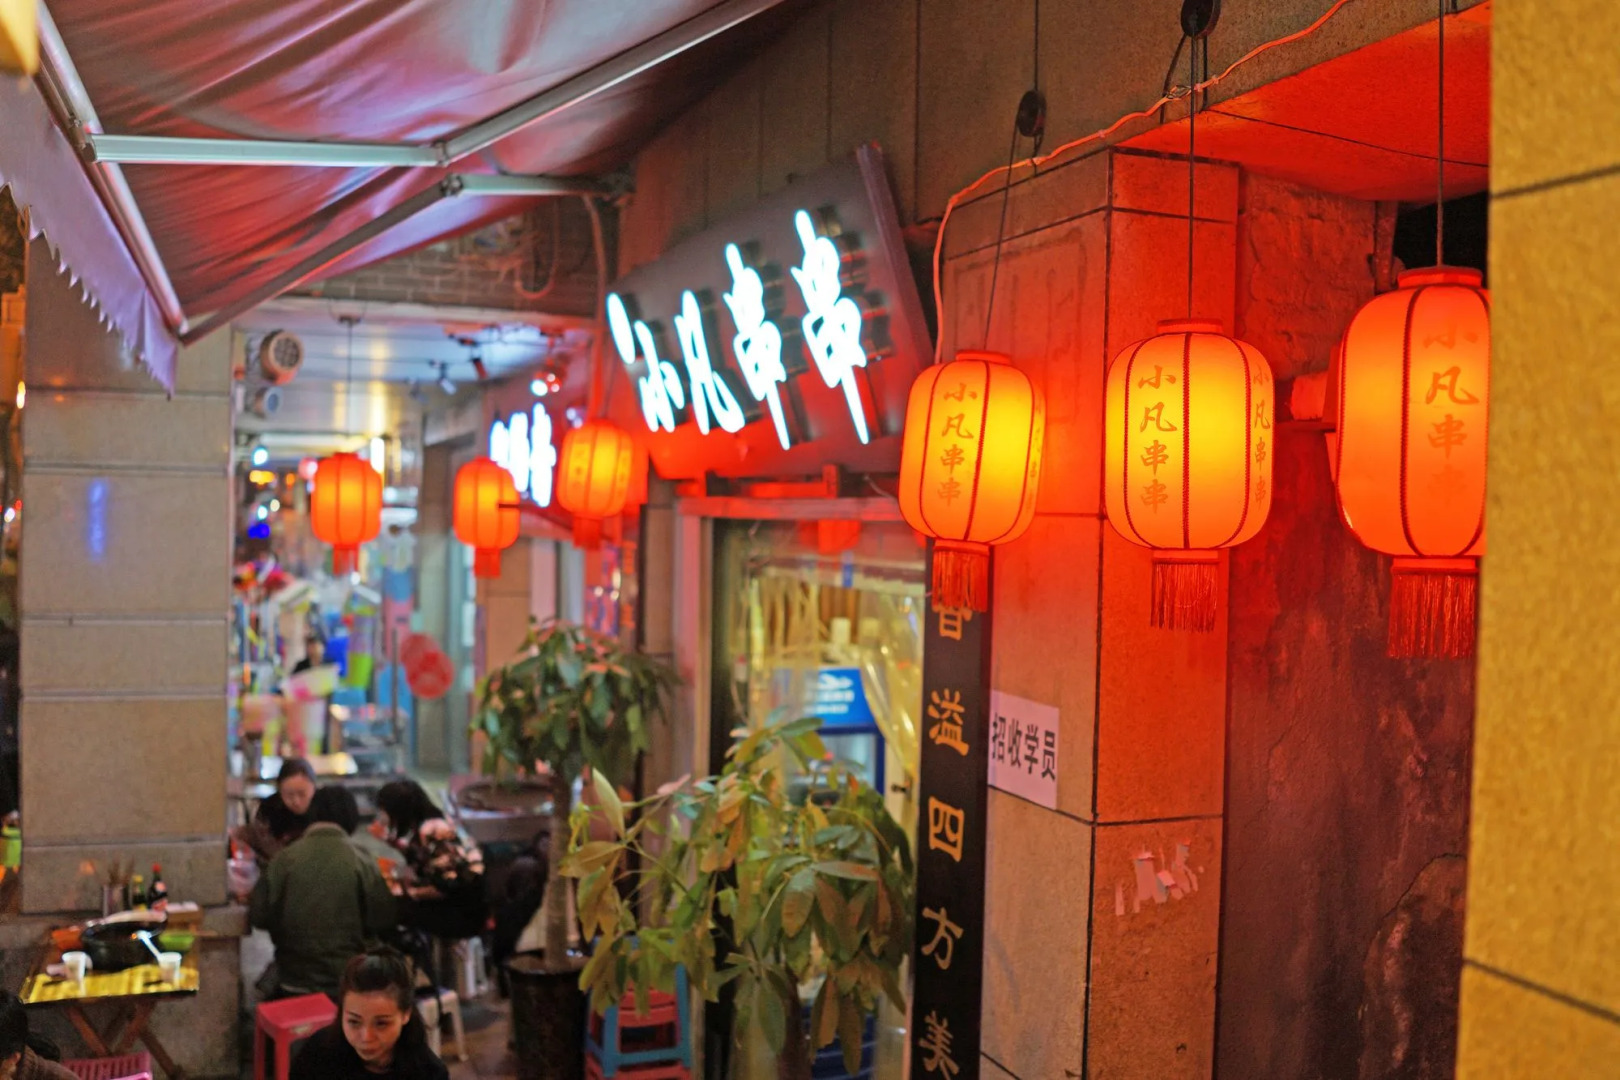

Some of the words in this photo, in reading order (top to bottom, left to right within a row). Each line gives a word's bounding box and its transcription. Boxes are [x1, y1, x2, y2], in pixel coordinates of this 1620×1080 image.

[937, 381, 979, 507] 小凡串串
[1138, 364, 1178, 514] 小凡串串
[1252, 363, 1271, 511] 小凡串串
[1423, 322, 1480, 507] 小凡串串
[991, 712, 1057, 782] 招收学员
